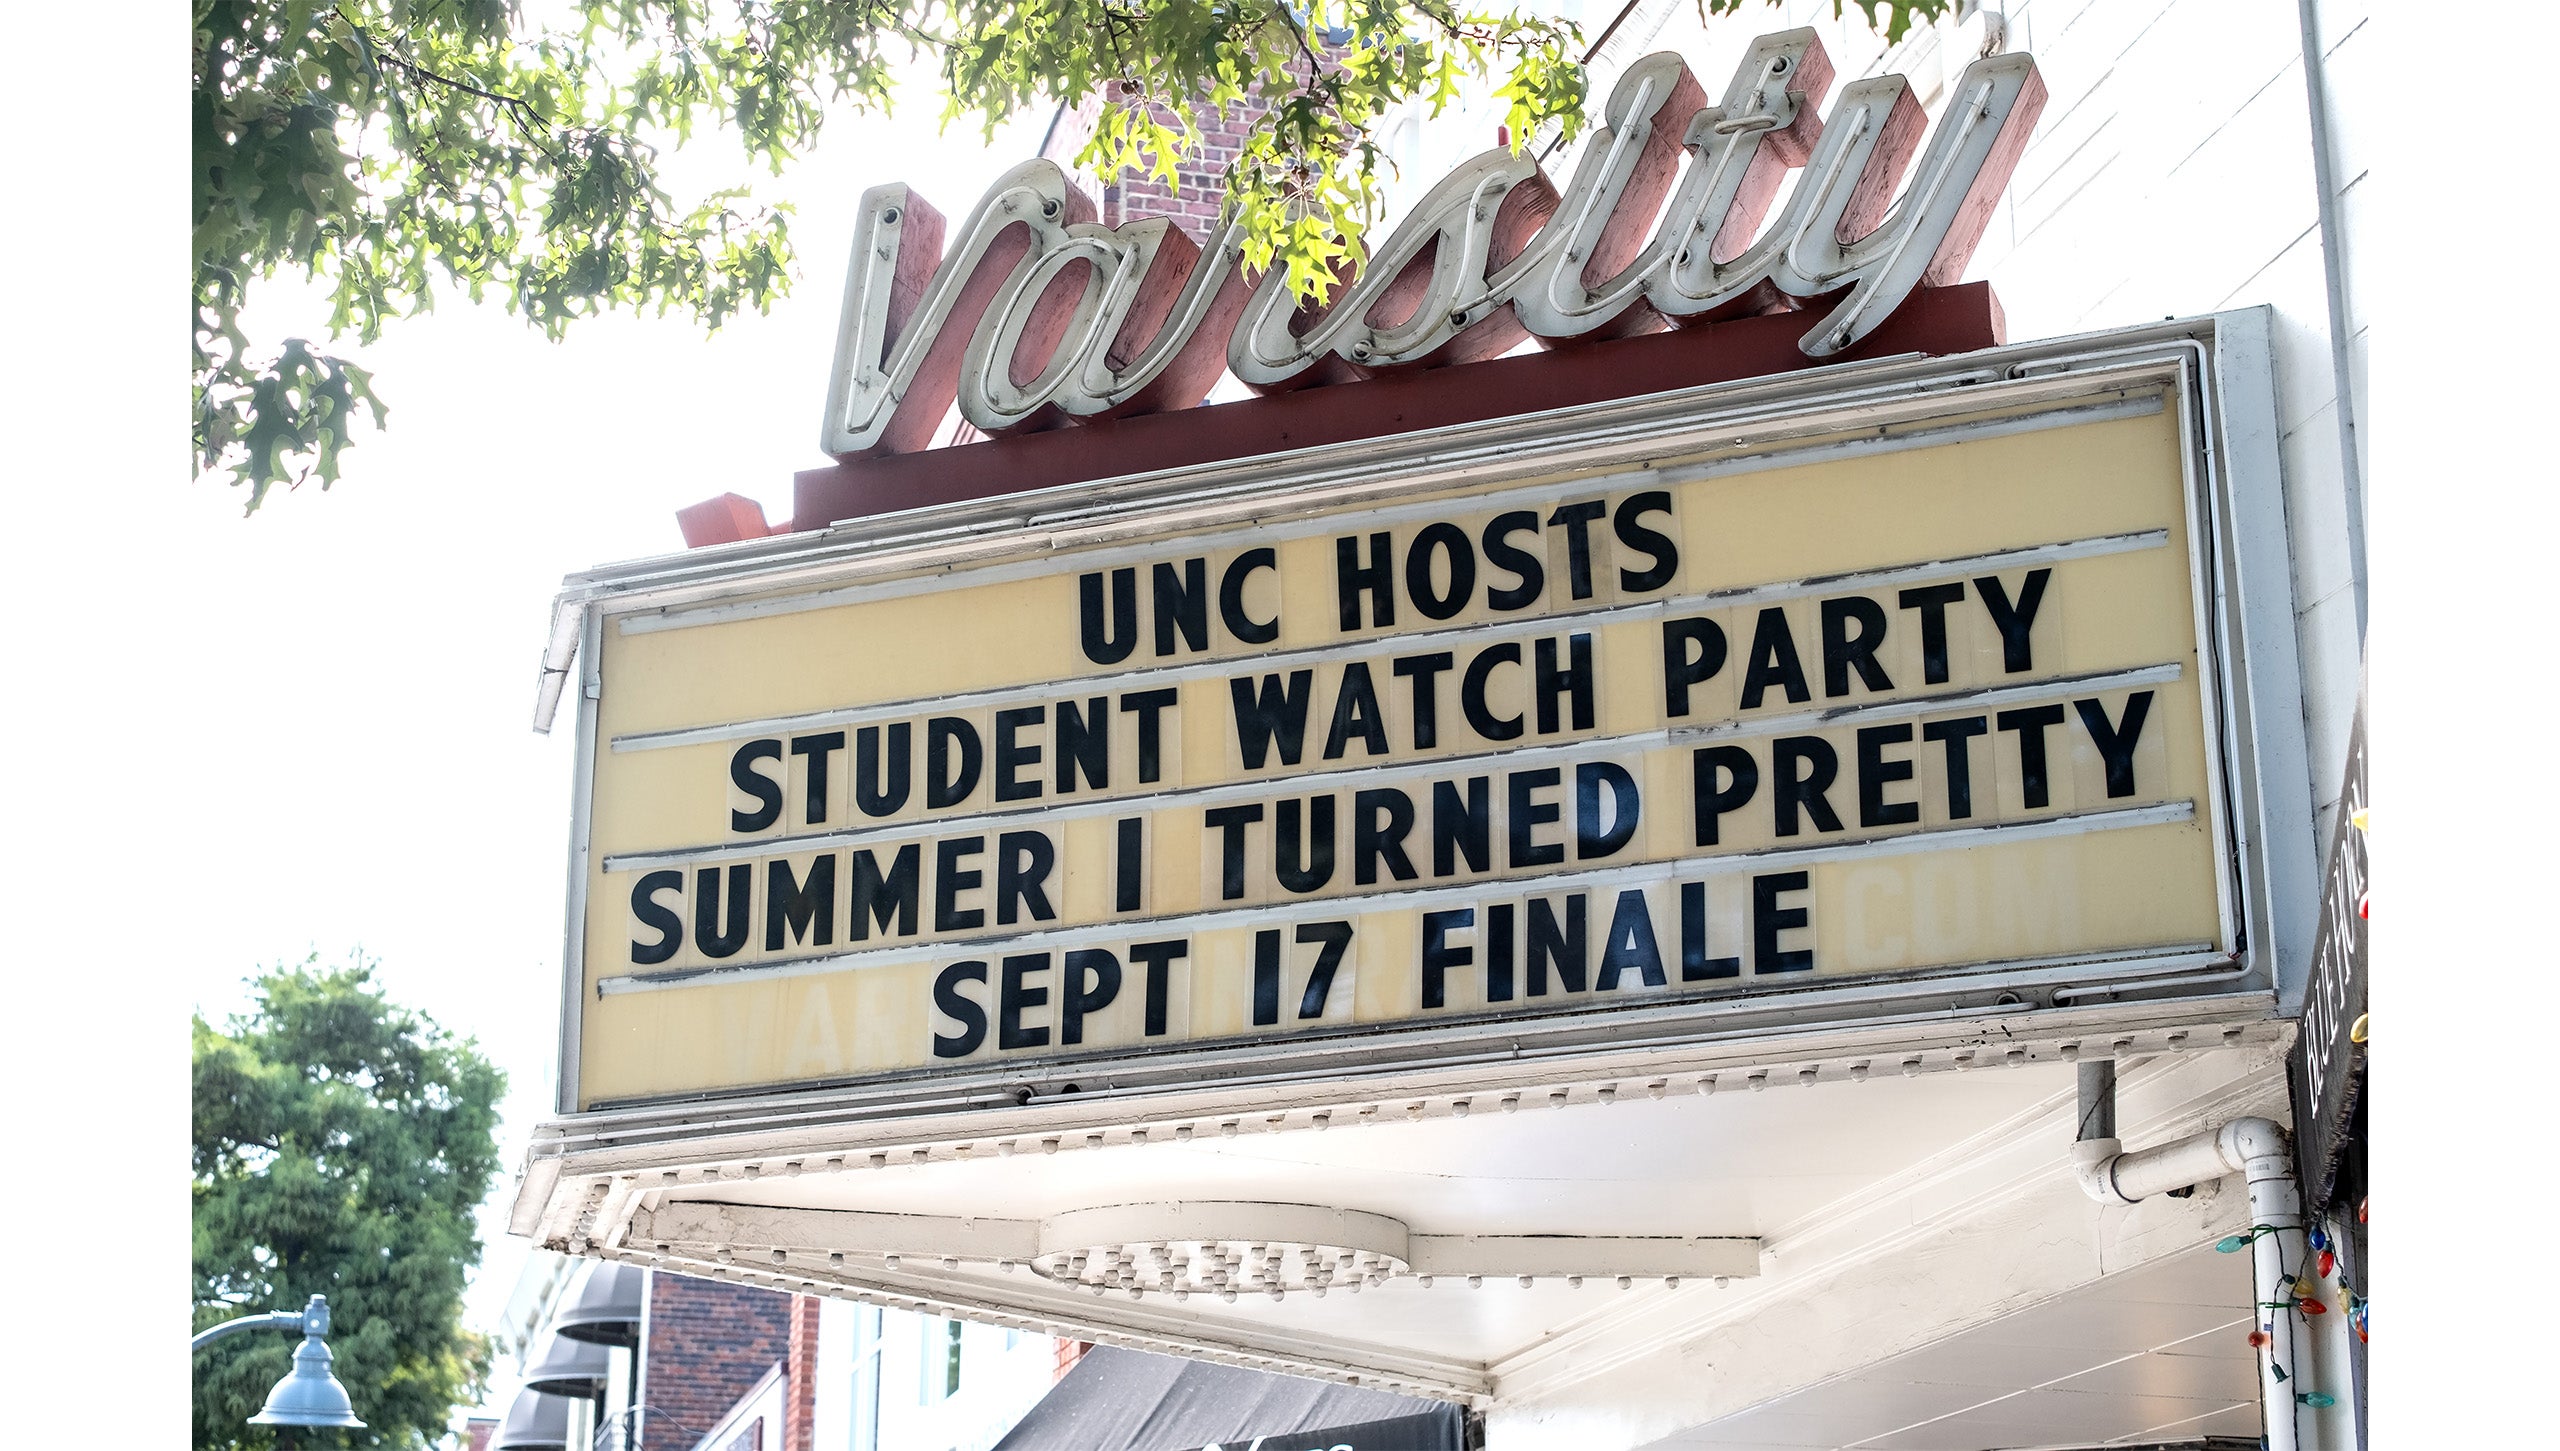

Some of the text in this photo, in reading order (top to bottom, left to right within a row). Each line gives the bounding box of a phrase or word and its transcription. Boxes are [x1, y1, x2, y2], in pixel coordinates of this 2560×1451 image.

[821, 26, 2046, 460] Varsity
[1079, 490, 1680, 666] UNC HOSTS
[730, 567, 2053, 833] STUDENT WATCH PARTY
[630, 689, 2155, 965] SUMMER I TURNED PRETTY
[932, 938, 1188, 1059] SEPT
[1252, 920, 1354, 1027] 17
[1421, 870, 1814, 1010] FINALE
[2304, 931, 2338, 1120] BLUE
